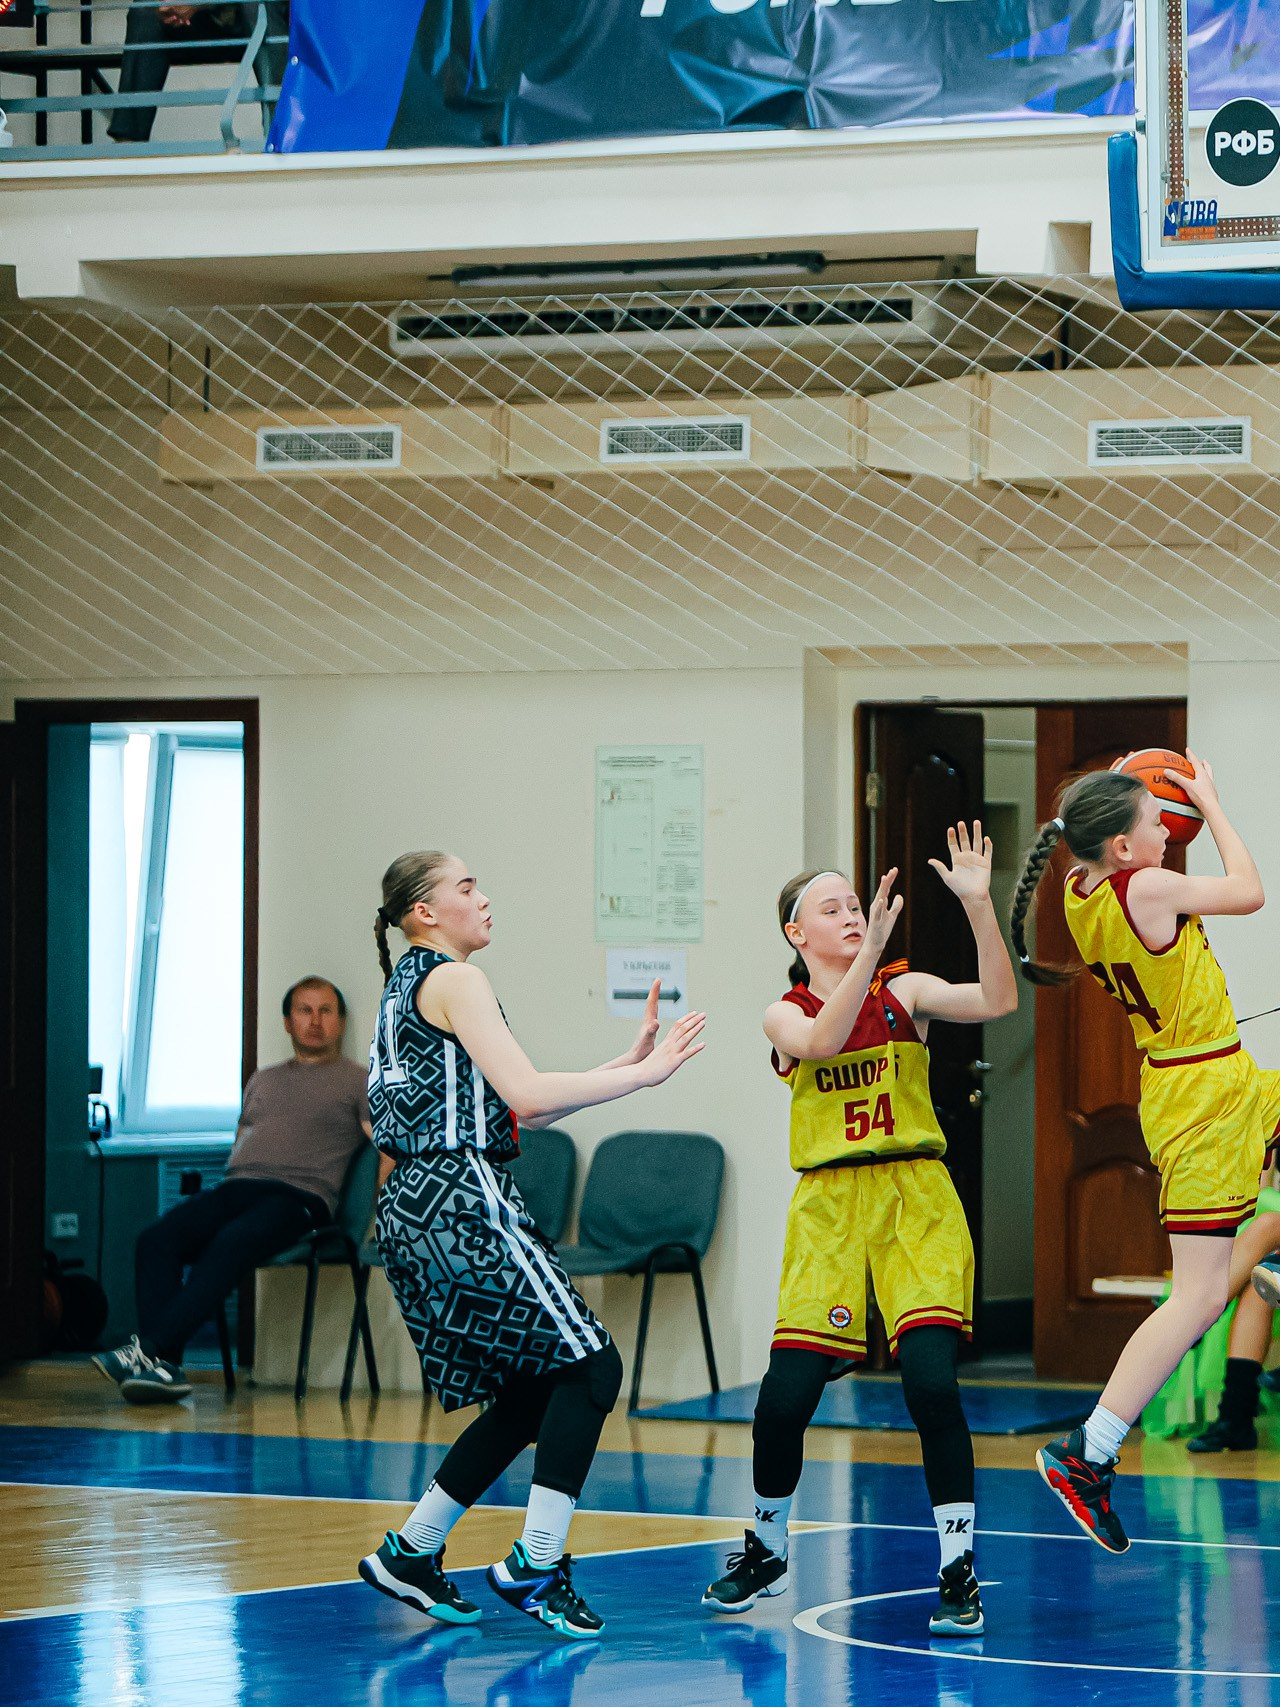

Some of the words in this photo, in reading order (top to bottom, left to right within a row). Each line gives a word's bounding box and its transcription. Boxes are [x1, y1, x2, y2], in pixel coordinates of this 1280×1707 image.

[1214, 129, 1275, 157] РФБ
[1179, 199, 1218, 228] FIBA
[844, 1092, 896, 1142] 54
